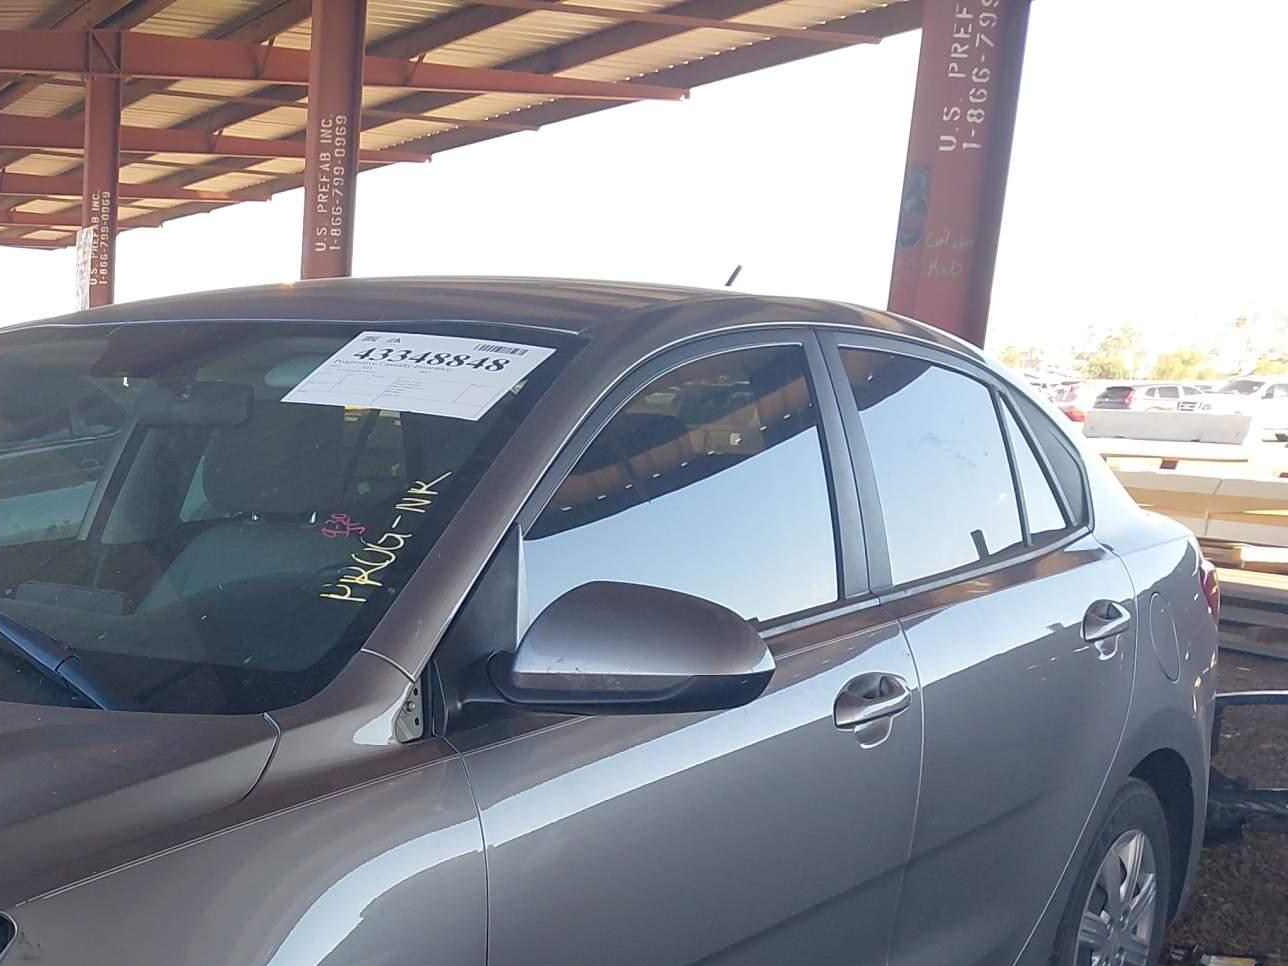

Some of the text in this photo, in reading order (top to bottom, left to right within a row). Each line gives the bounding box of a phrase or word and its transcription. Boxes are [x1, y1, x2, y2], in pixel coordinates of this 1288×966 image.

[939, 98, 963, 151] U.S.
[91, 190, 100, 211] INC.
[315, 114, 333, 252] U.S. PREFAB INC.
[329, 115, 347, 250] 1-866-799-0969
[99, 191, 110, 285] 1-866-799-0969
[353, 347, 510, 372] 43348848
